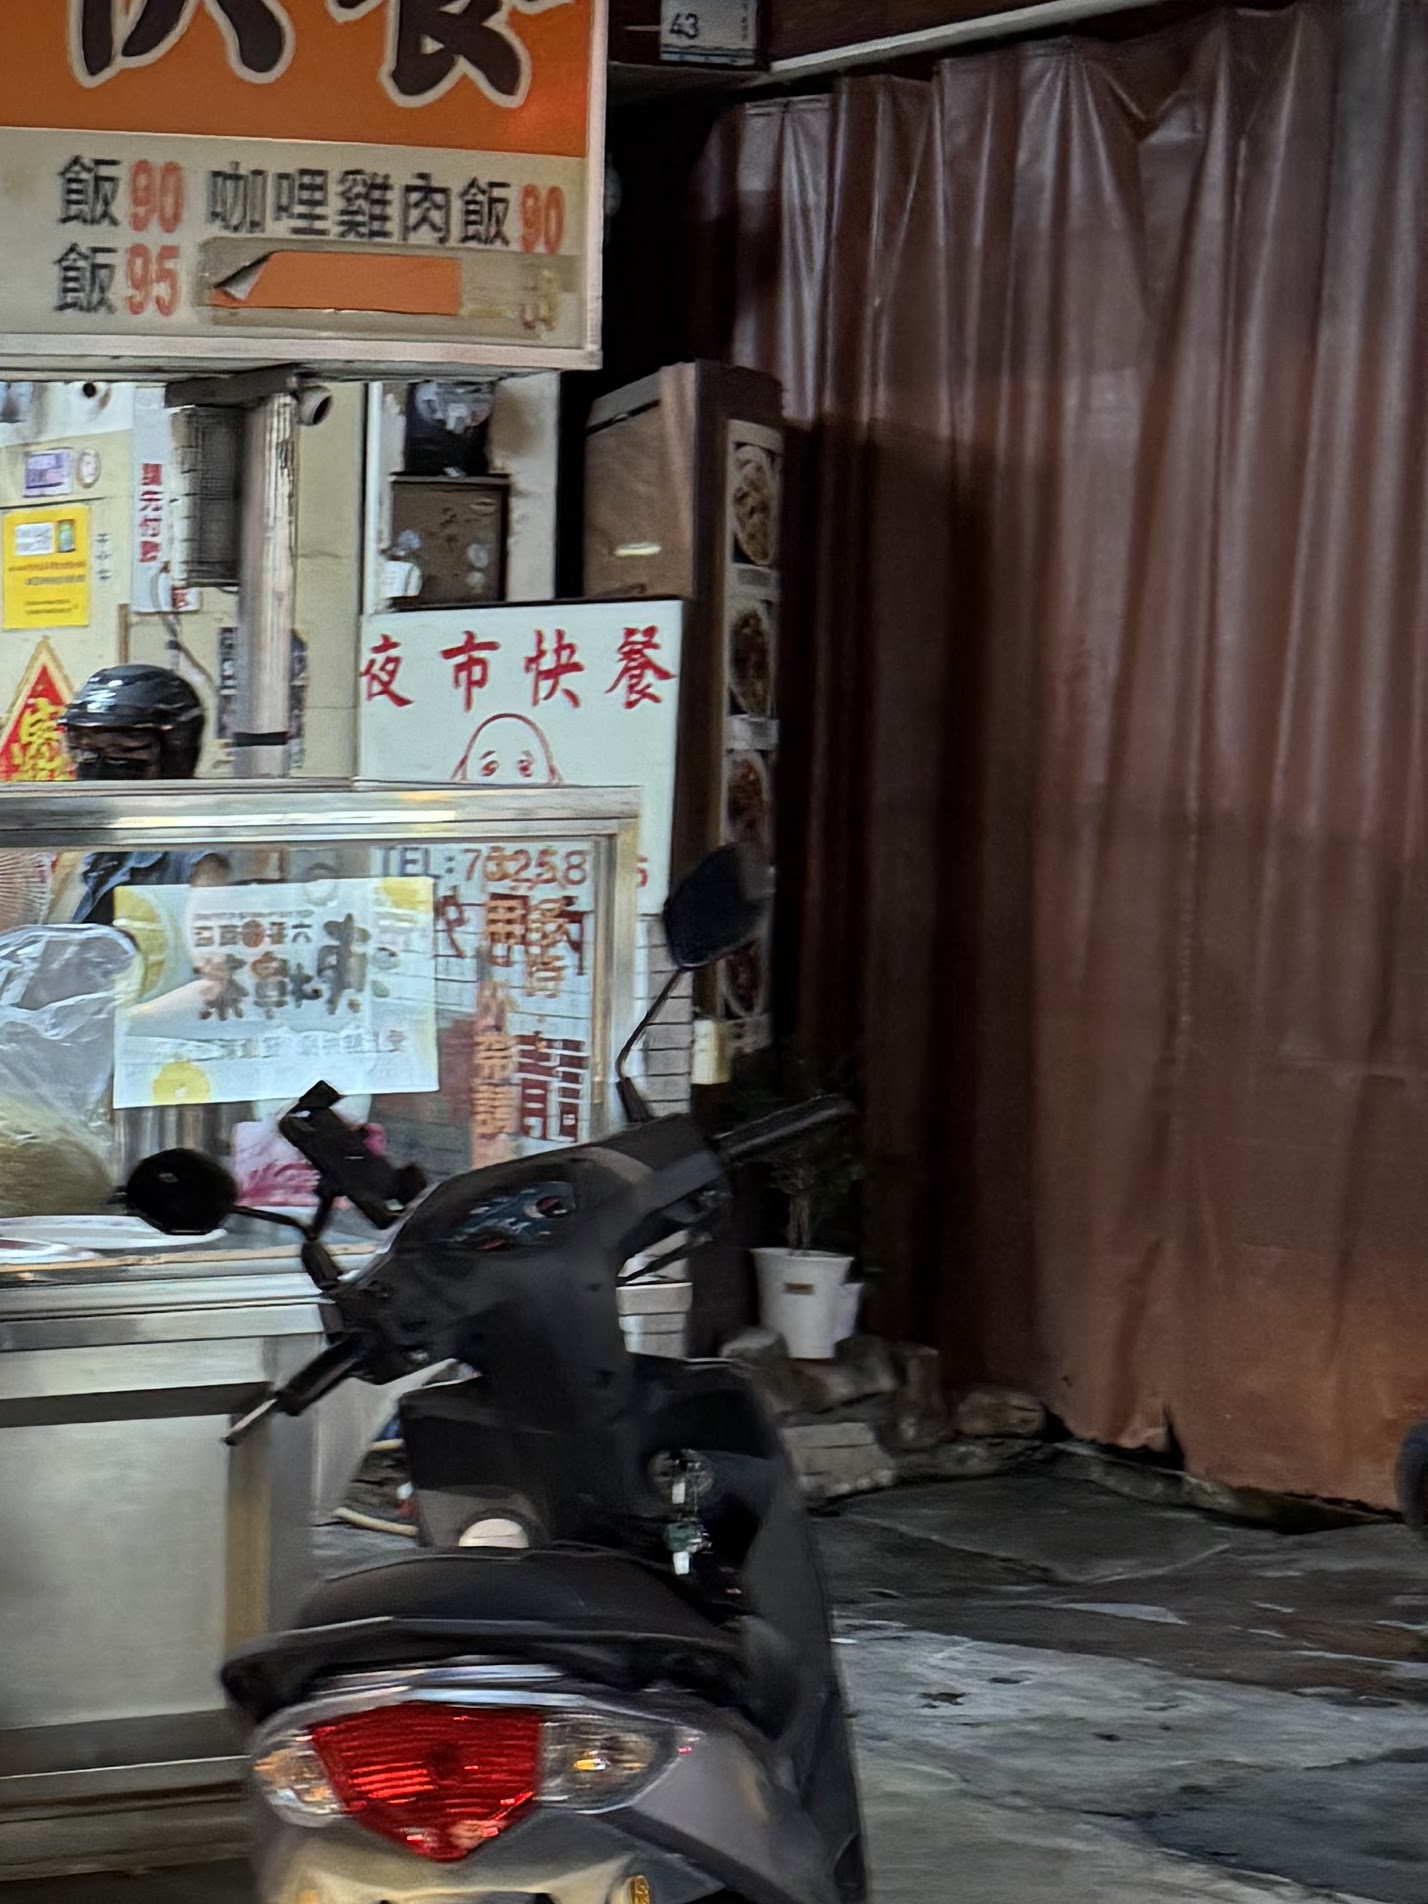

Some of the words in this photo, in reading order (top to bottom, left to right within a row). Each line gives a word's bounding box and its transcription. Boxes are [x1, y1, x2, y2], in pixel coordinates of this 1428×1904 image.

[128, 159, 185, 234] 90
[204, 161, 515, 248] 咖哩雞肉飯
[125, 244, 180, 316] 95
[359, 626, 677, 712] 夜市快餐
